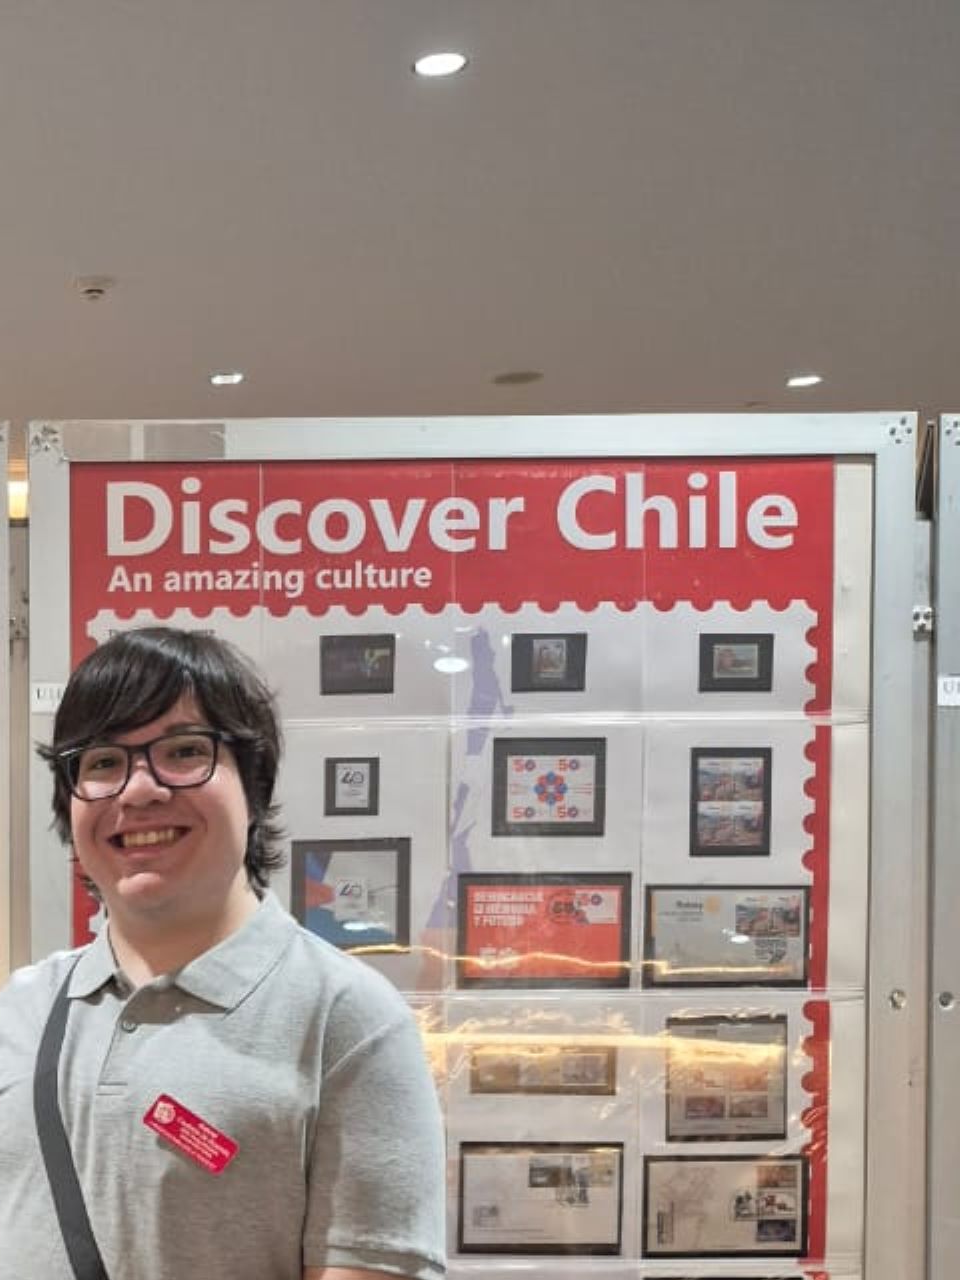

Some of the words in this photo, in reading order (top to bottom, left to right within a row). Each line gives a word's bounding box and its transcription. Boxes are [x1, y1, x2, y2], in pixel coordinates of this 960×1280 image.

[106, 477, 524, 556] Discover
[557, 471, 798, 550] Chile
[107, 565, 152, 592] An
[164, 562, 304, 598] amazing
[316, 561, 432, 588] culture
[513, 759, 536, 772] 50
[558, 759, 580, 771] 50
[512, 806, 535, 819] 50
[557, 806, 578, 818] 50
